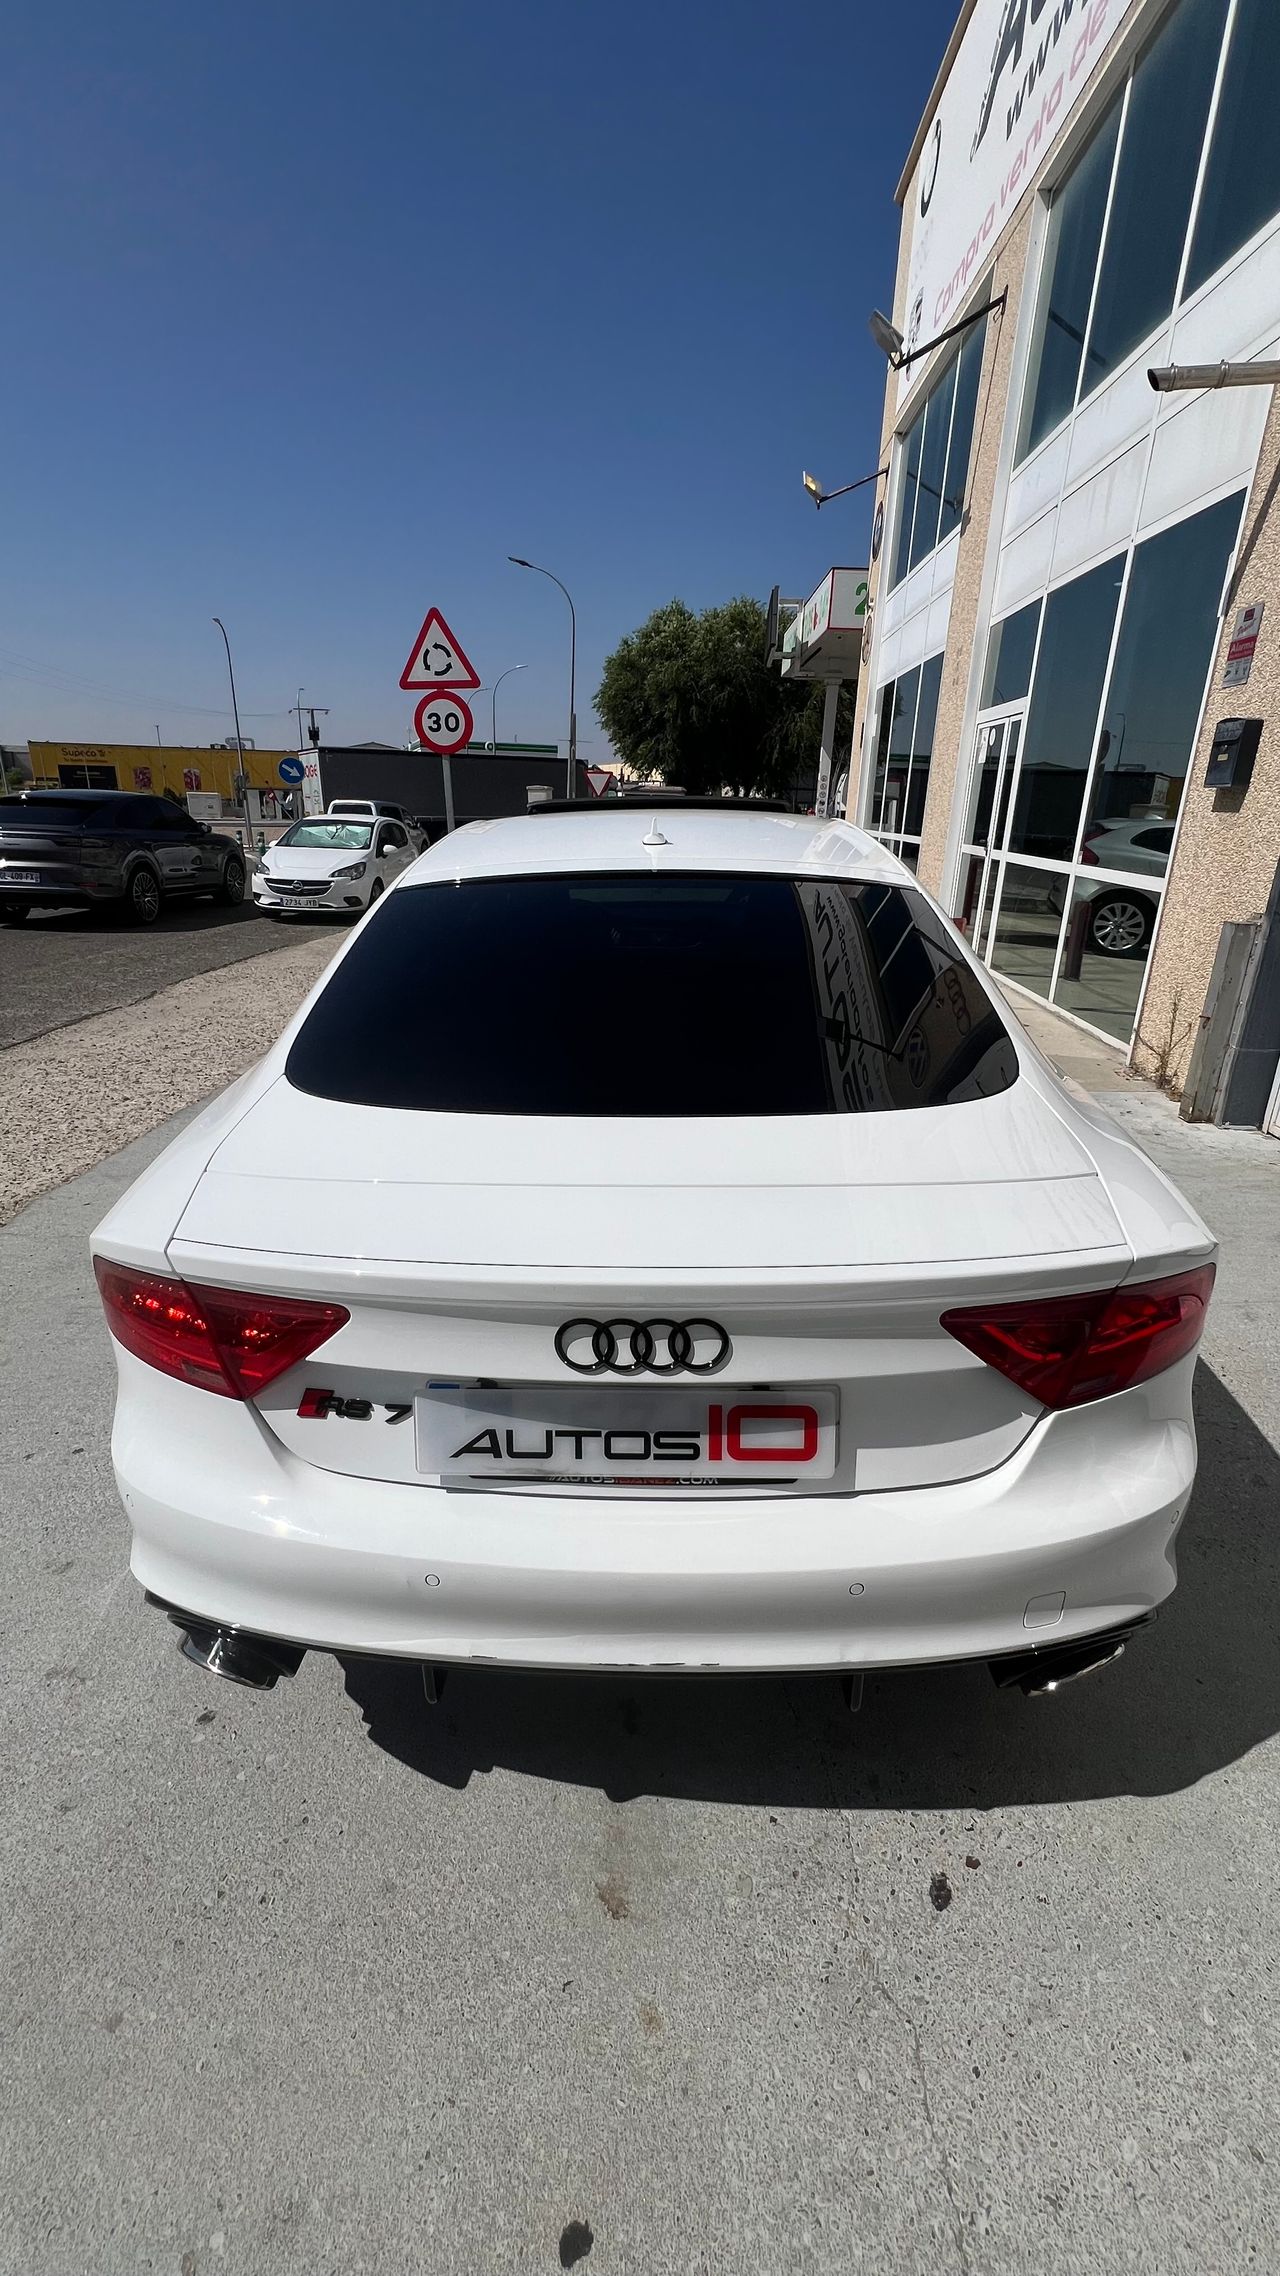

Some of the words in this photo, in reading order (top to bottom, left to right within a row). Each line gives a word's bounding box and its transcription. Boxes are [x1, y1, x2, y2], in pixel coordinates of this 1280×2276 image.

[999, 72, 1064, 209] venta
[1069, 0, 1108, 81] de
[427, 712, 460, 733] 30
[61, 747, 97, 758] Supeco
[312, 1392, 374, 1420] RS
[384, 1403, 413, 1425] 7
